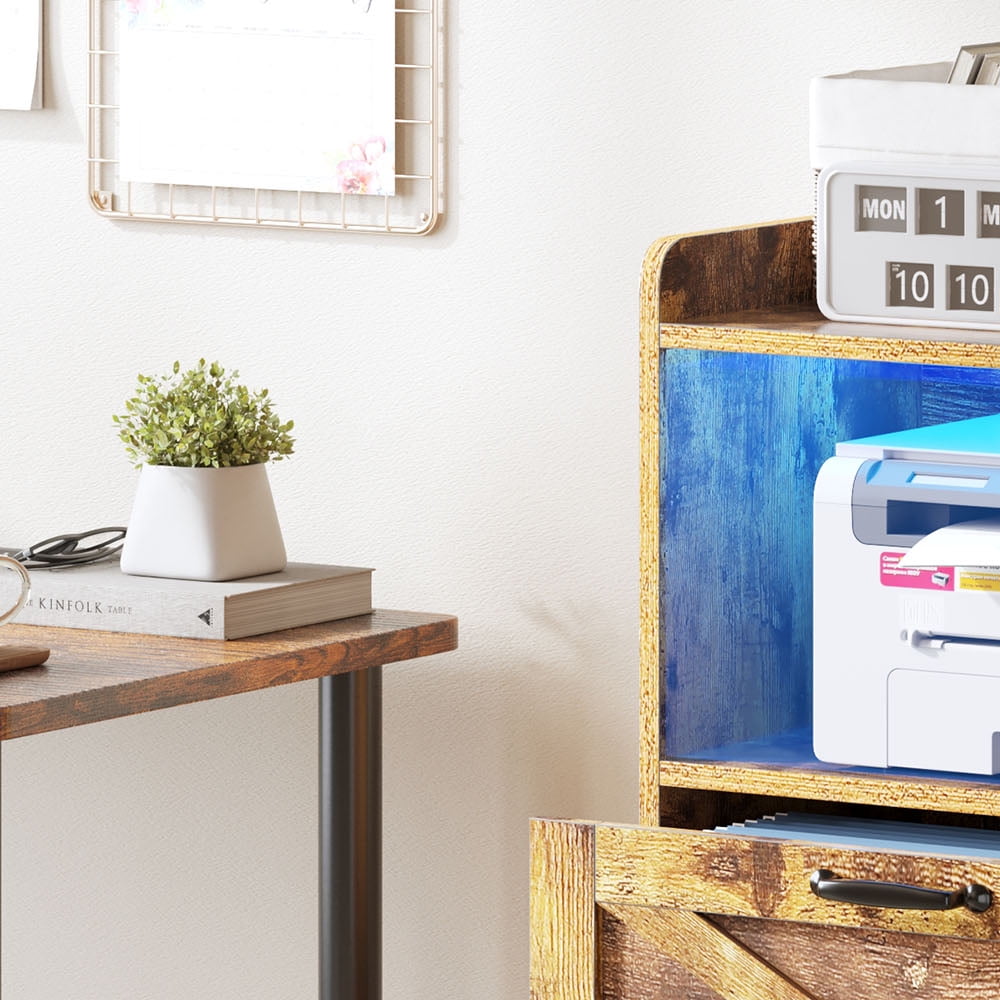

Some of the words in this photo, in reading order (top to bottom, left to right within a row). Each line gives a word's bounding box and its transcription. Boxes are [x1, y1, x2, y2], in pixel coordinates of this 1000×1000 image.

[862, 198, 906, 220] MON
[935, 195, 946, 229] 1
[895, 269, 929, 302] 10
[955, 273, 989, 305] 10
[39, 597, 103, 614] KINFOLK
[107, 605, 133, 615] TABLE
